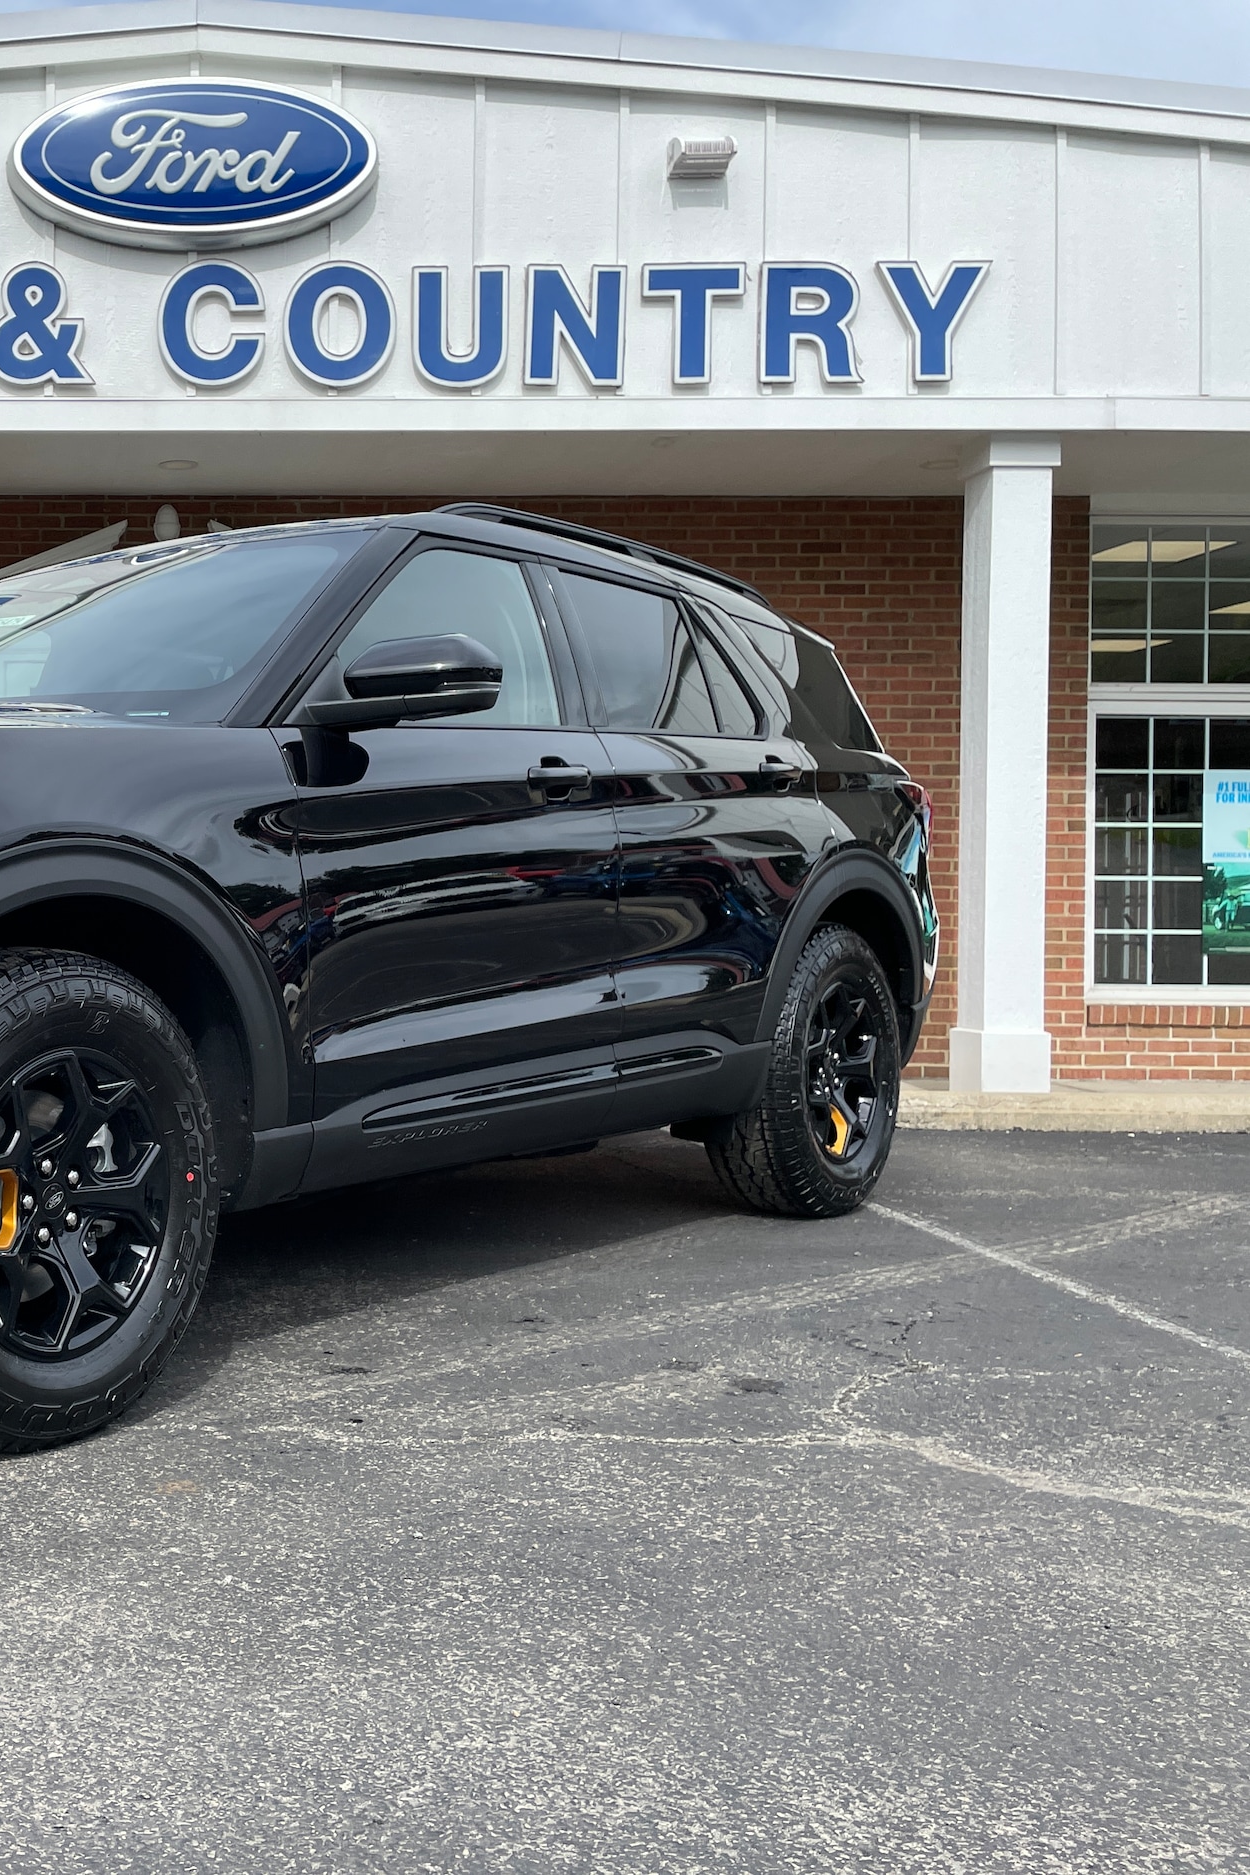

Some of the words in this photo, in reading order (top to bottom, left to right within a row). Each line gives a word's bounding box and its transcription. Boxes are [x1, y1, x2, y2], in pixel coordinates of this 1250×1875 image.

[89, 109, 301, 195] Ford
[157, 258, 993, 387] COUNTRY
[1215, 792, 1235, 803] FOR
[1217, 781, 1230, 792] #1
[366, 1120, 489, 1149] EXPLORER
